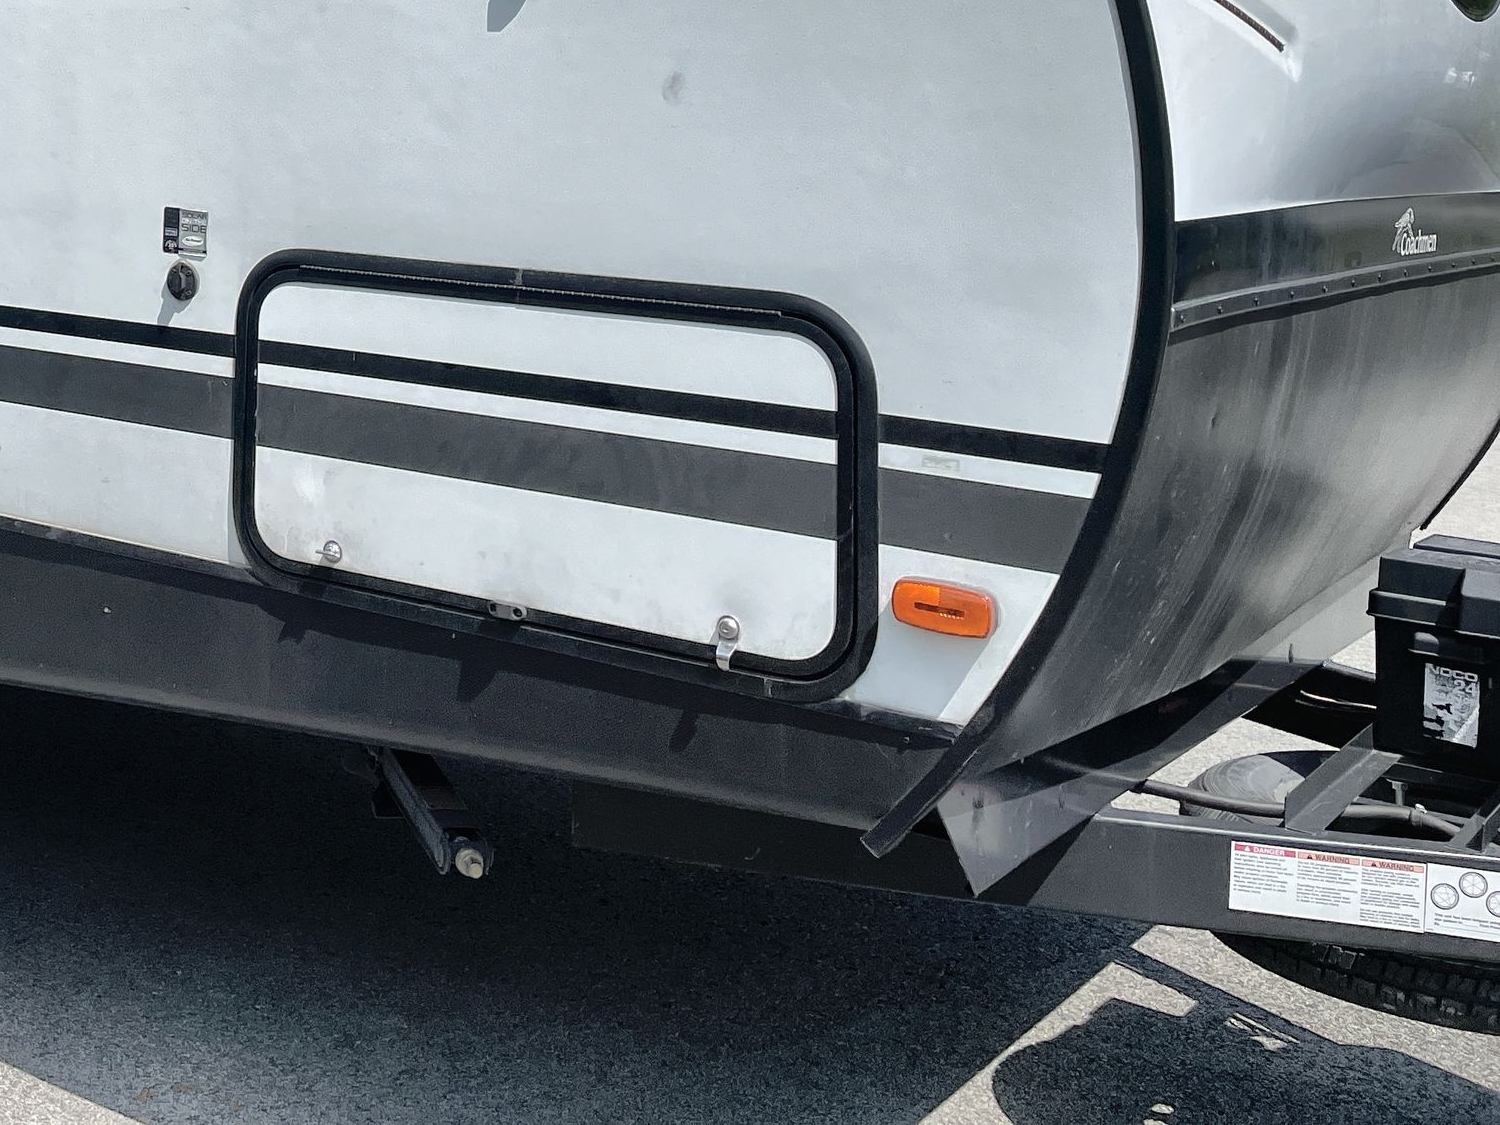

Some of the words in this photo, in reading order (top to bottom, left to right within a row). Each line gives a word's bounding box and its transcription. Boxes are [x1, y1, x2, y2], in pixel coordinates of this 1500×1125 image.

[181, 223, 206, 233] SIDE
[1425, 663, 1478, 682] NOCO
[1453, 679, 1476, 696] 24
[1253, 845, 1285, 857] DANGER
[1314, 853, 1351, 865] WARNING
[1379, 861, 1415, 873] WARNING
